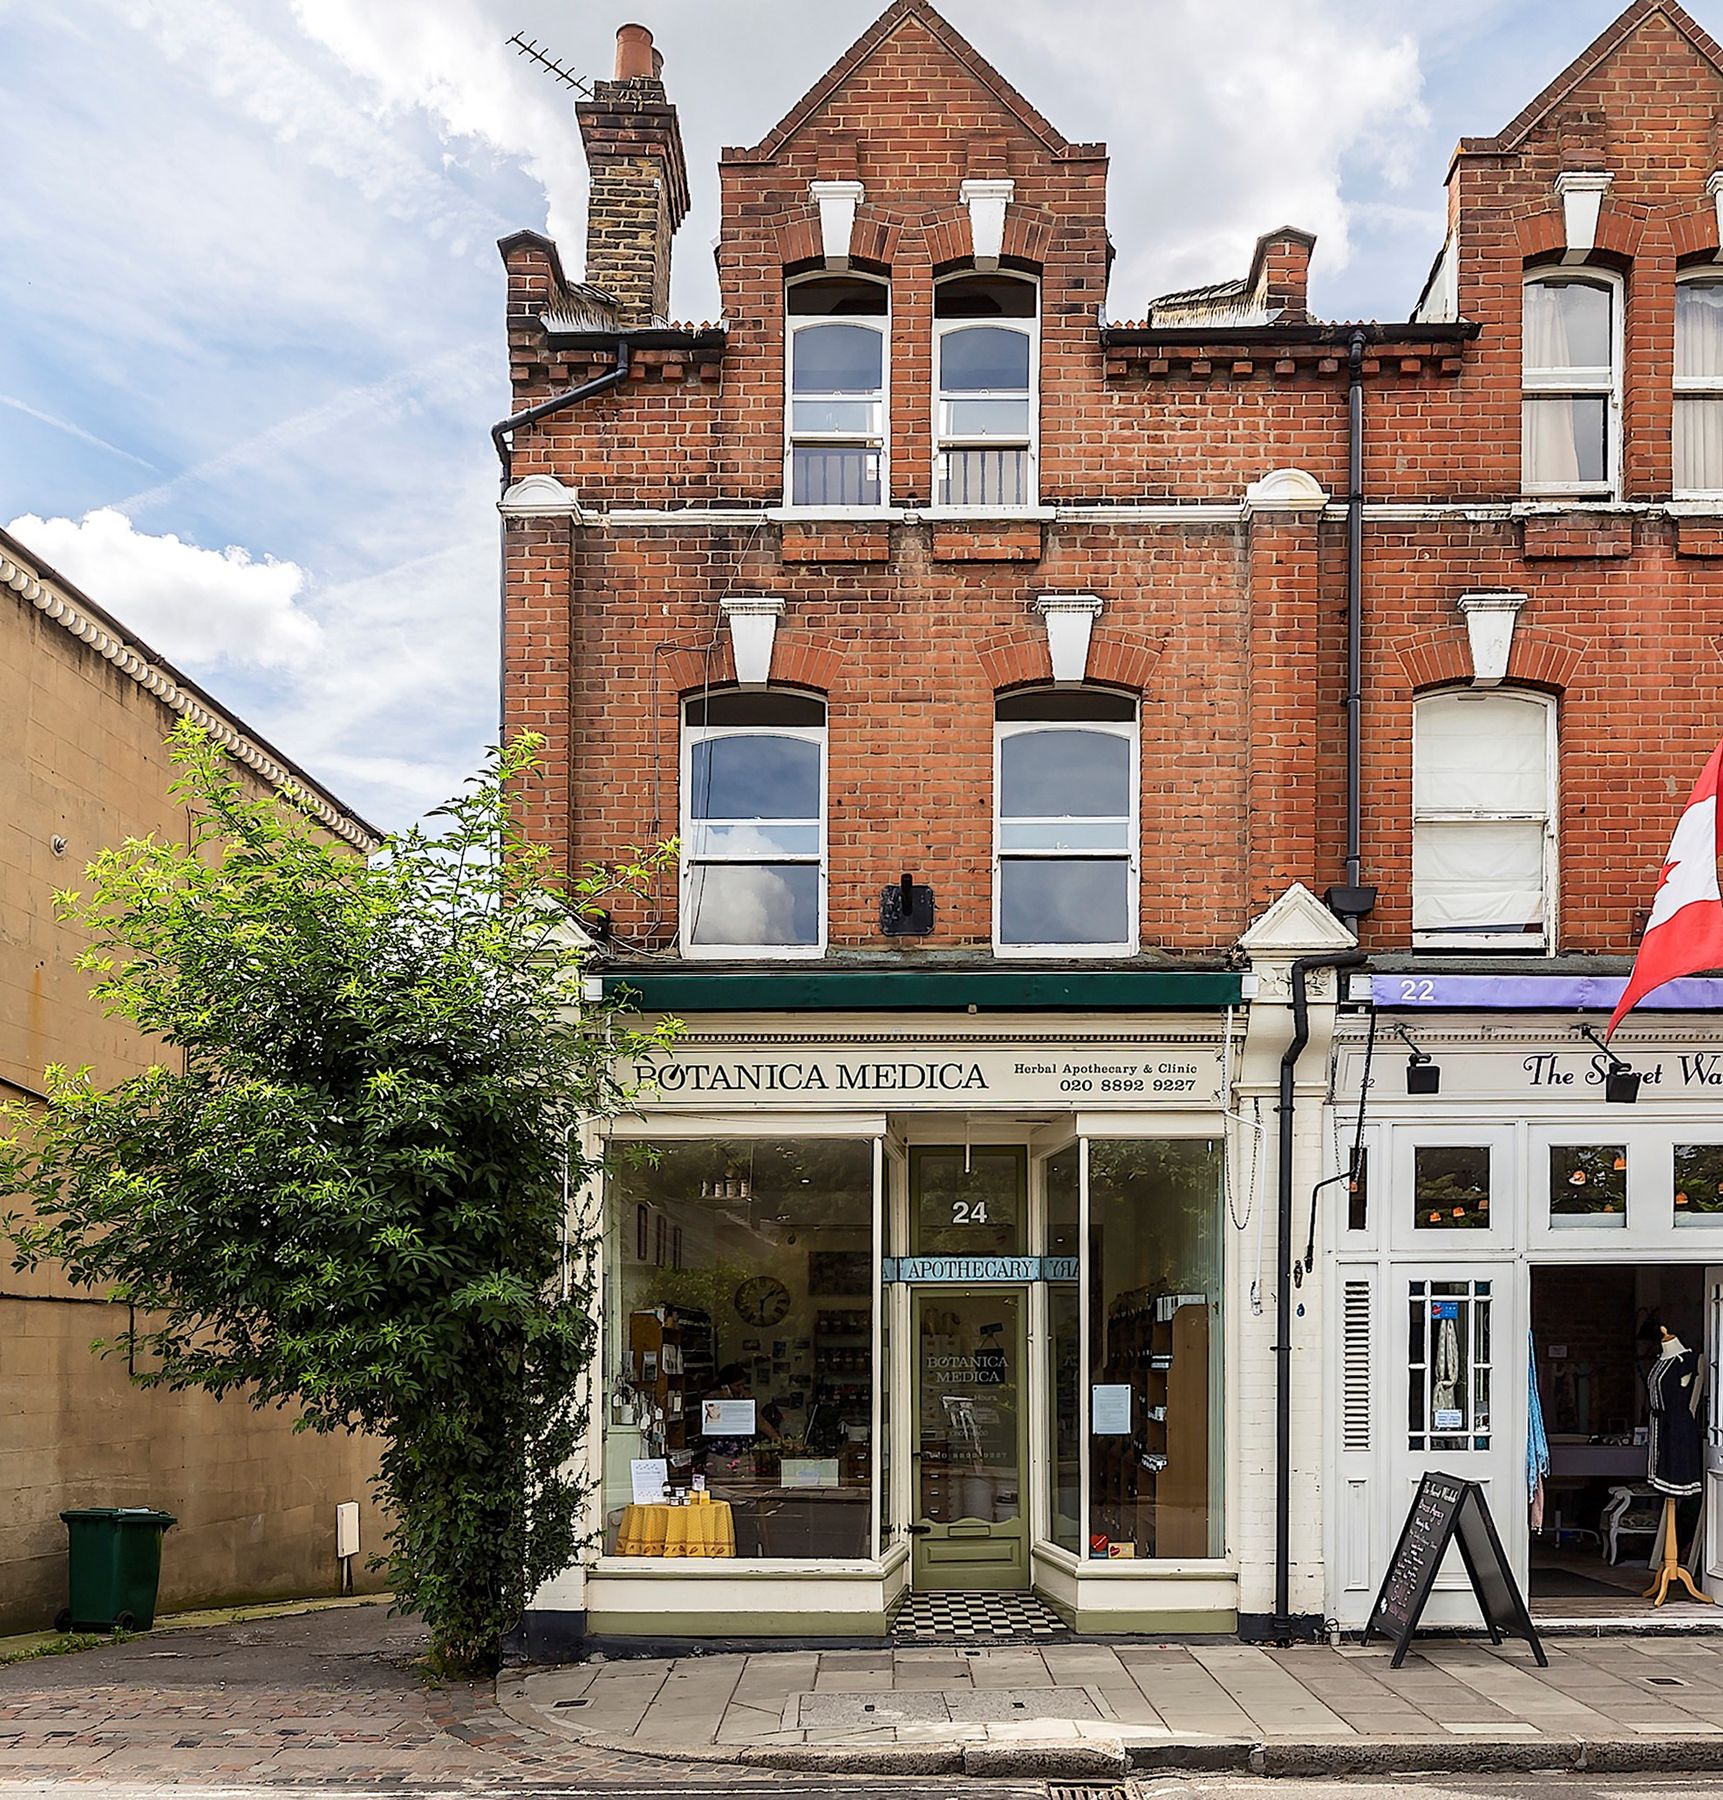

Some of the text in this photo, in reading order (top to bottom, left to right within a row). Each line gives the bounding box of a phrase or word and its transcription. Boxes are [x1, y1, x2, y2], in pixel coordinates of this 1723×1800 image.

[1400, 979, 1435, 1001] 22
[632, 1063, 990, 1091] BOTANICA MEDICA
[1014, 1063, 1198, 1076] Herbal Apothecary & Clinic
[1523, 1052, 1575, 1086] The
[1585, 1054, 1663, 1085] Set
[1060, 1079, 1197, 1092] 020 8892 9227
[952, 1201, 988, 1224] 24
[908, 1261, 1033, 1279] APOTHECARY
[927, 1356, 1010, 1369] BOTANICA
[936, 1371, 1001, 1383] MEDICA
